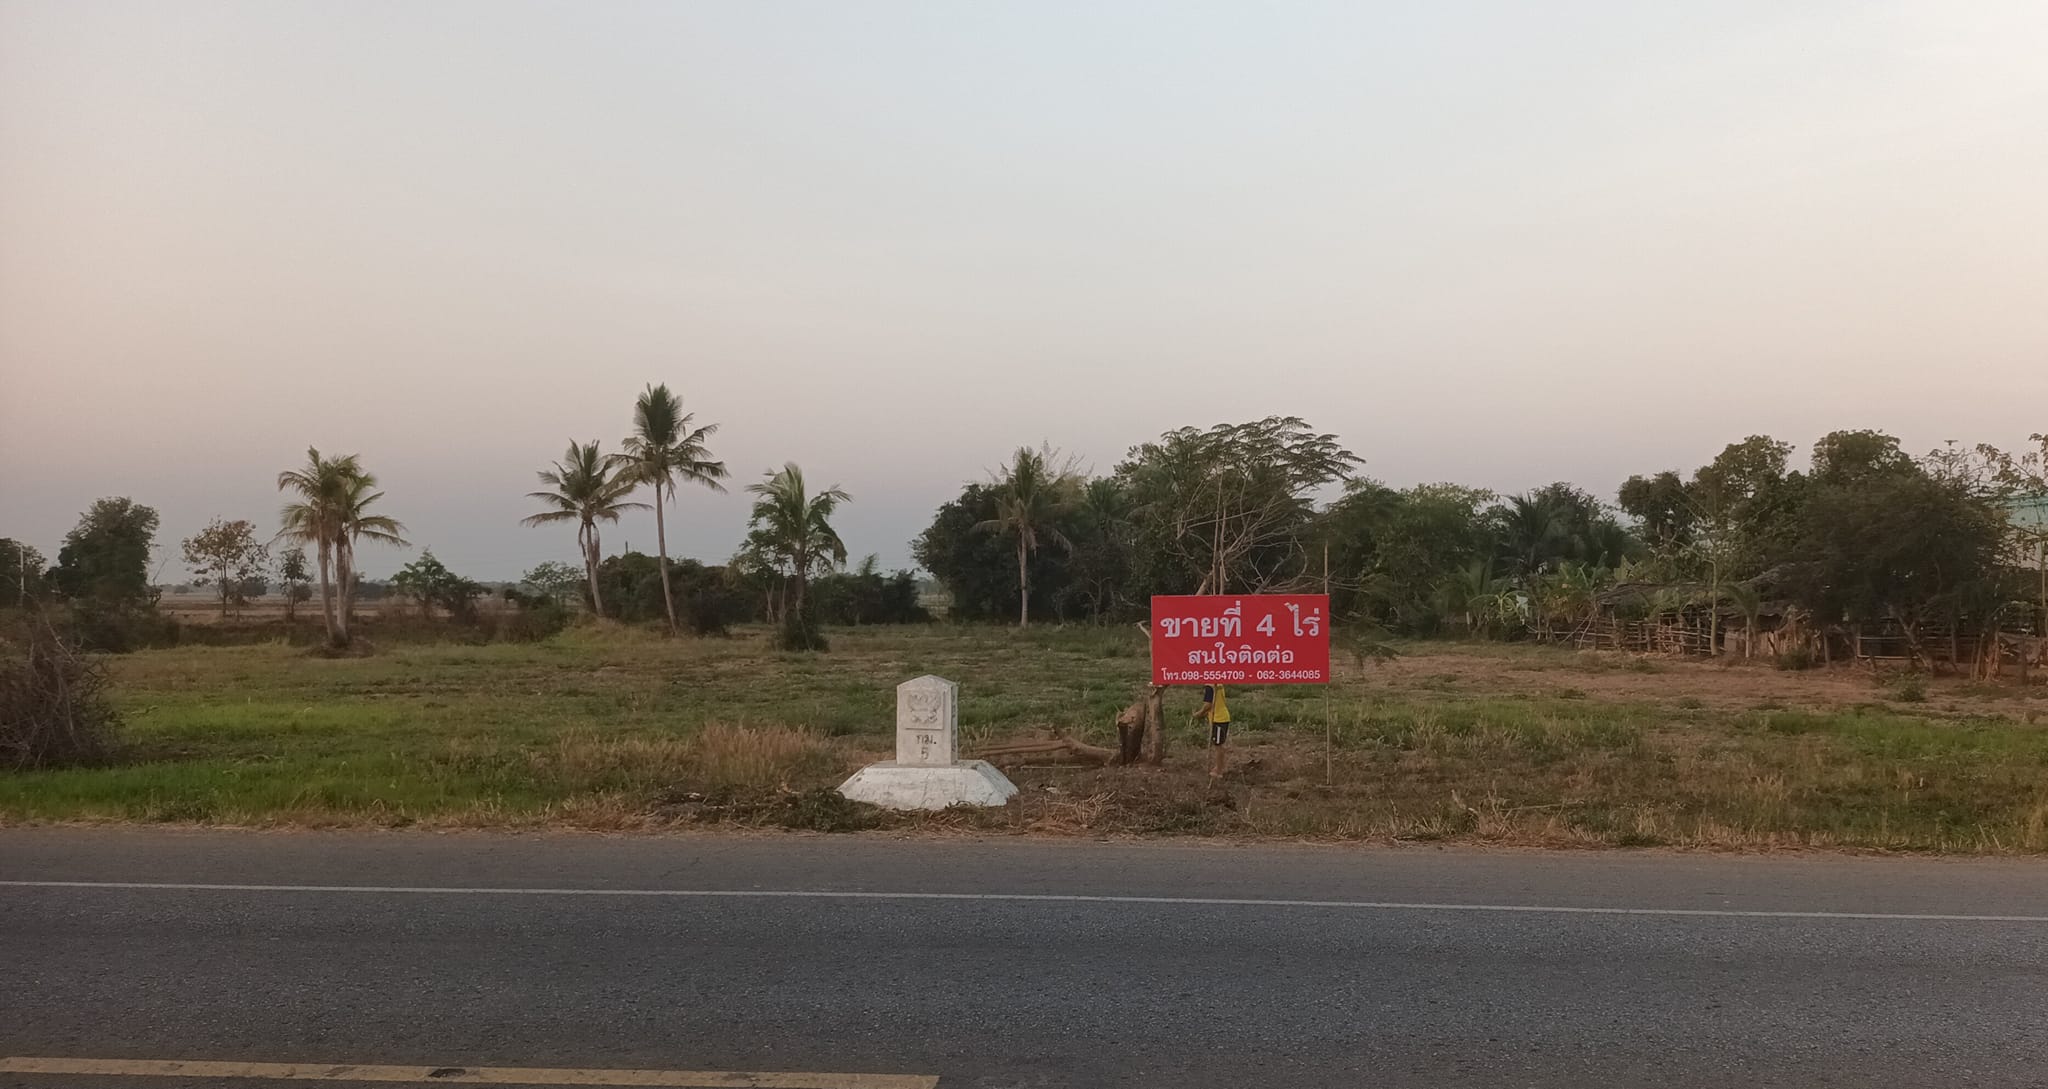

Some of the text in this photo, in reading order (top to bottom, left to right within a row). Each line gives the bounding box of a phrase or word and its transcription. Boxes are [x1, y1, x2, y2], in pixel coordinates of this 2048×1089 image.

[1160, 601, 1320, 637] ขายที่ 4 ไร่
[1188, 642, 1293, 664] สนใจติดต่อ
[1256, 670, 1321, 680] 062-3644085
